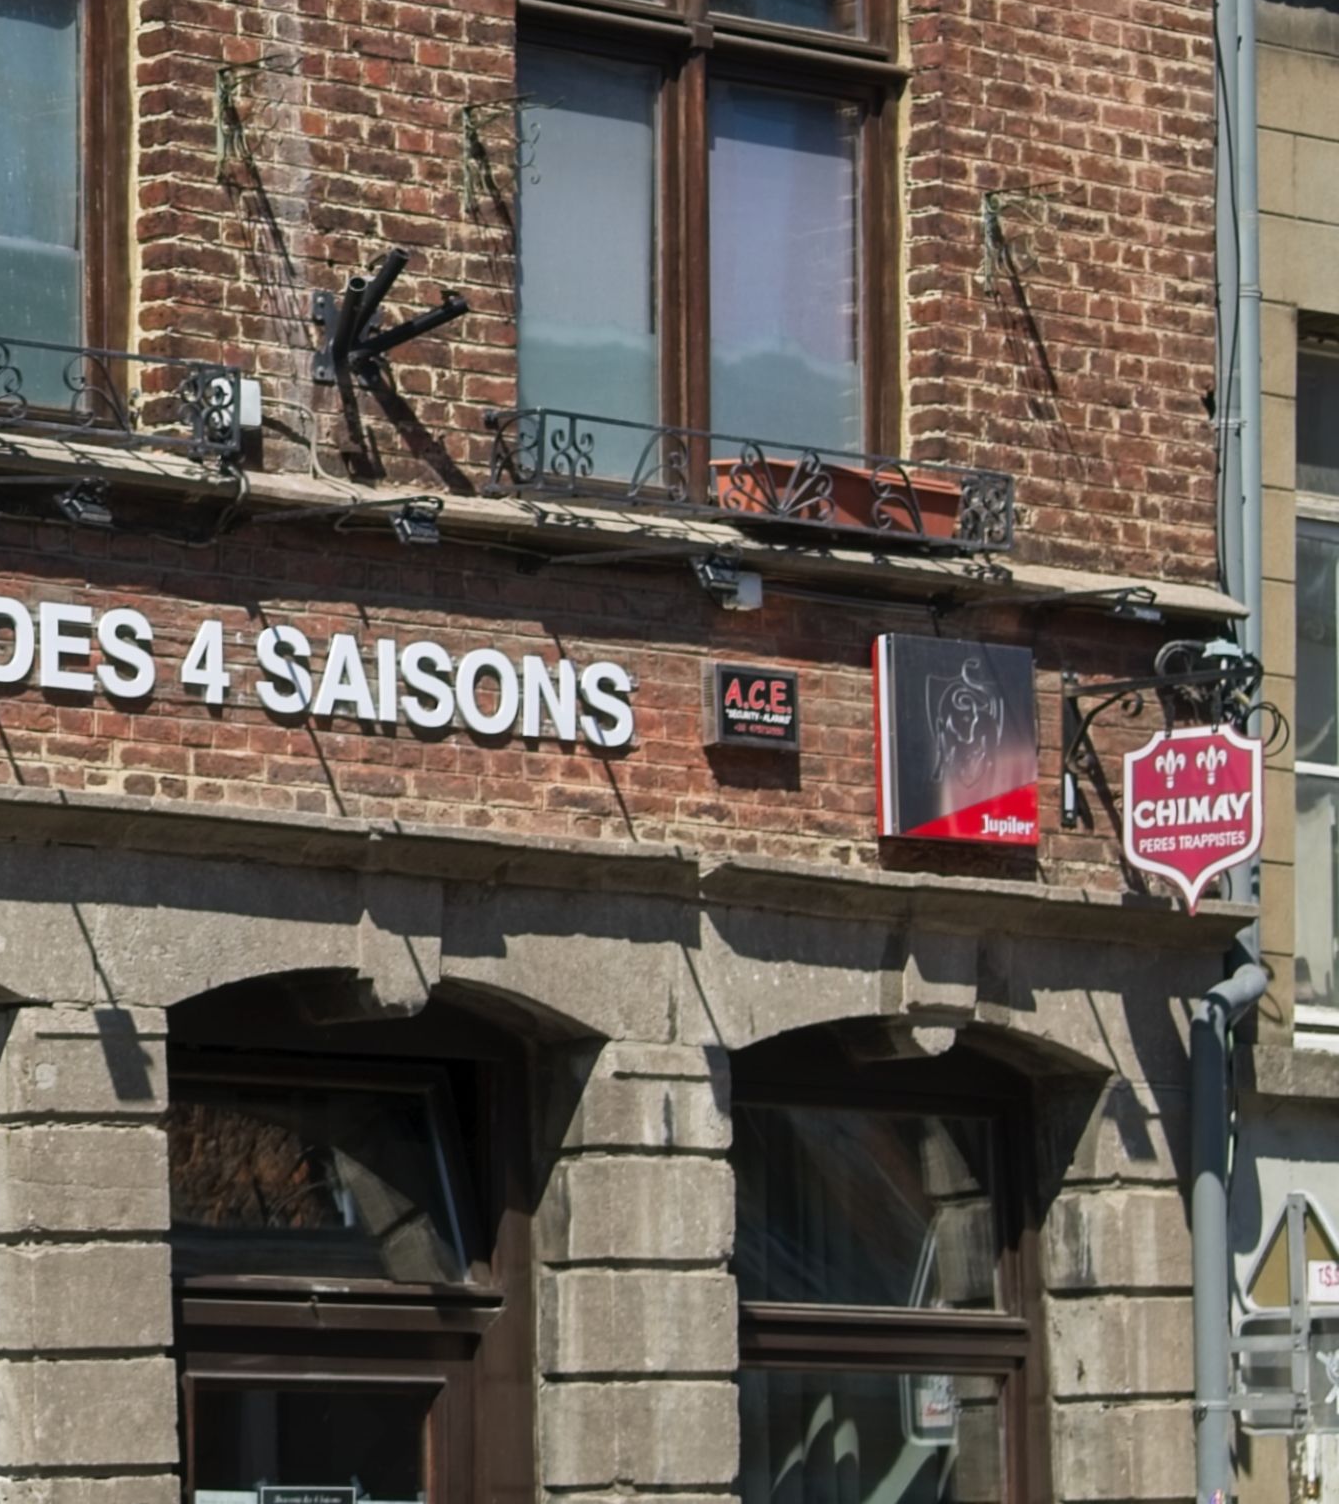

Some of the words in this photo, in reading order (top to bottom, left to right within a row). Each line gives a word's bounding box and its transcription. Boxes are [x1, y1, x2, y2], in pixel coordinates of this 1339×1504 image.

[180, 619, 231, 704] 4
[255, 625, 634, 748] SAISONS
[724, 678, 792, 714] A.C.E.
[980, 813, 1036, 837] Jupiler
[1133, 792, 1251, 828] CHIMAY
[1138, 834, 1177, 853] PERES
[1178, 830, 1247, 850] TRAPPISTES
